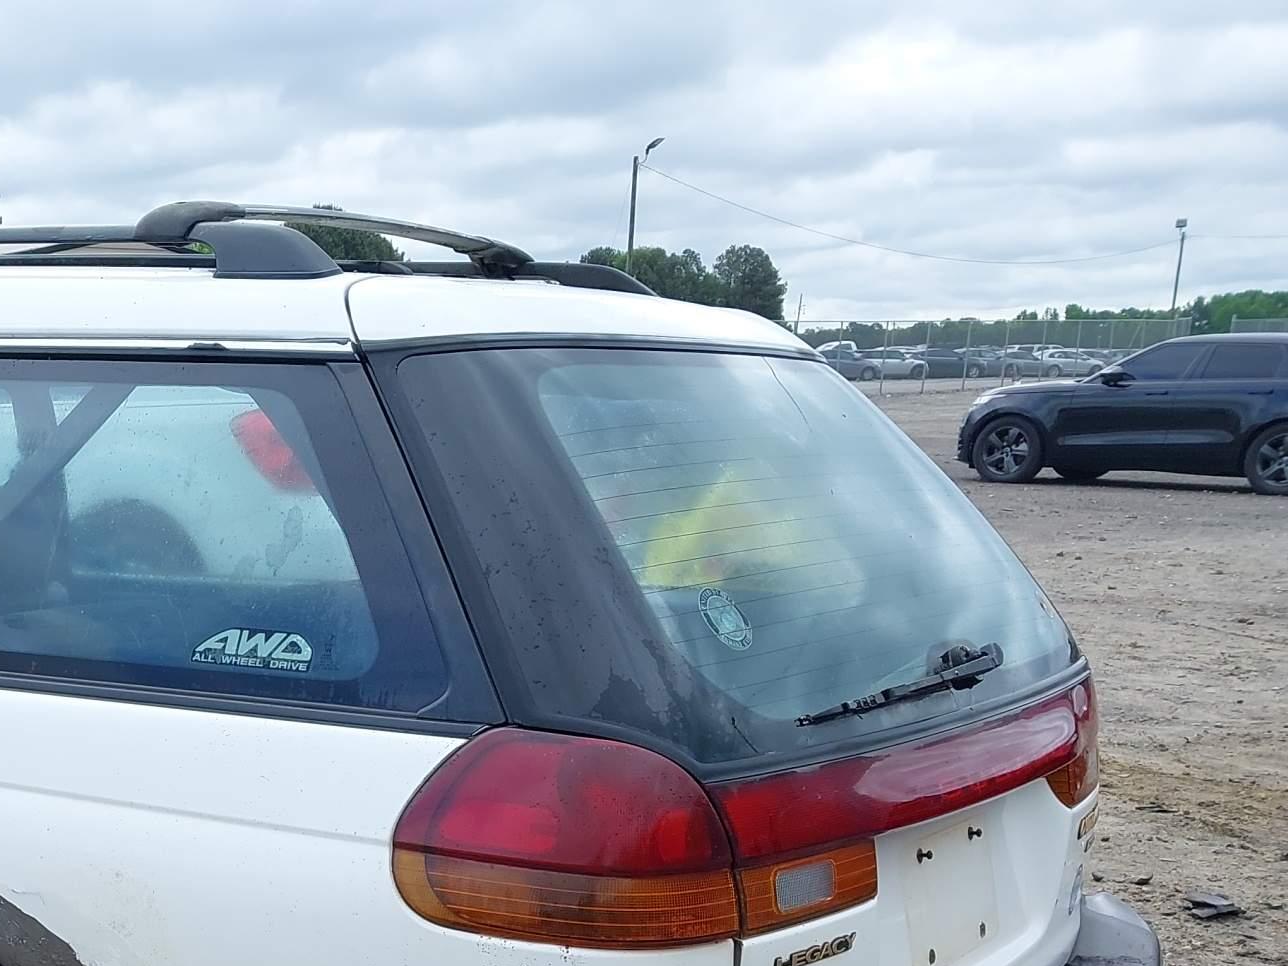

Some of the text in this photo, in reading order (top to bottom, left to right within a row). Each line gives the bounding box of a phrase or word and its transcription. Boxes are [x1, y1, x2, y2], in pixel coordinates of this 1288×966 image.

[195, 629, 312, 660] AWD
[192, 653, 309, 671] ALL WHEEL DRIVE
